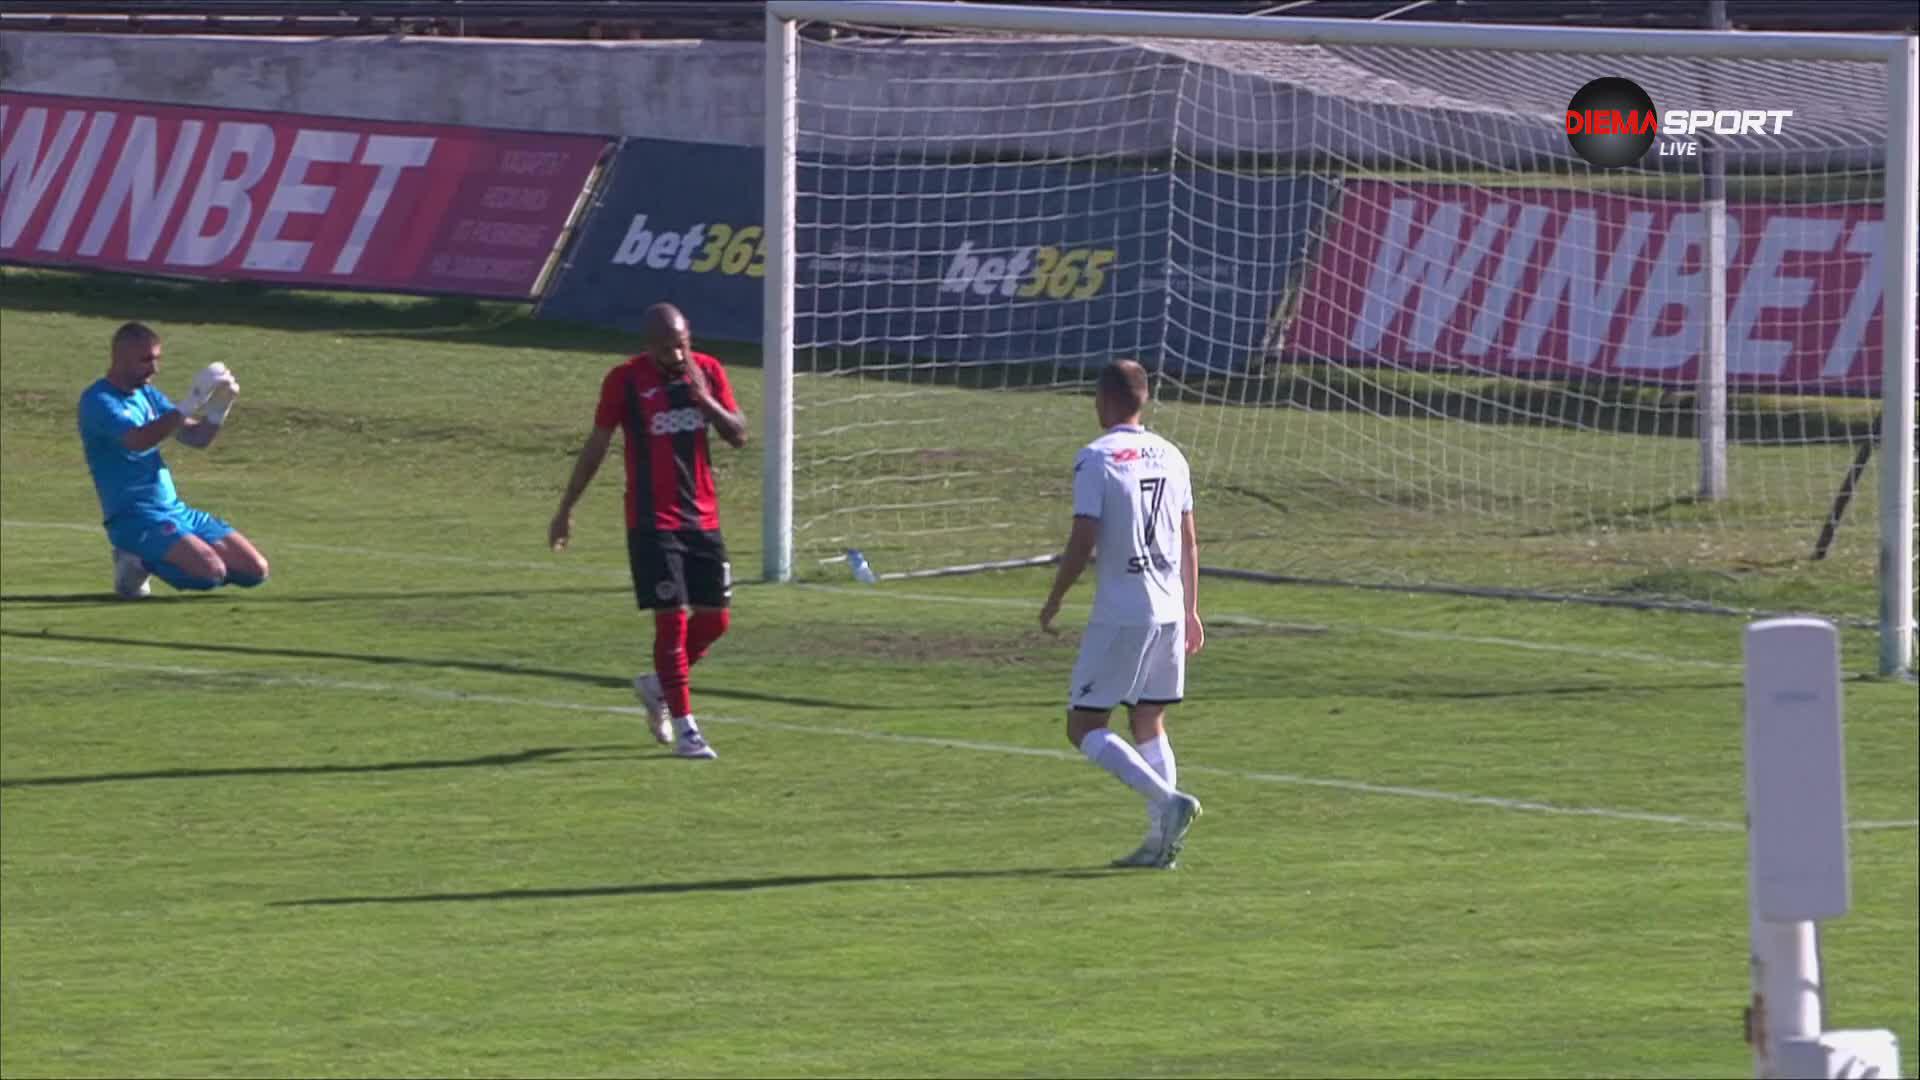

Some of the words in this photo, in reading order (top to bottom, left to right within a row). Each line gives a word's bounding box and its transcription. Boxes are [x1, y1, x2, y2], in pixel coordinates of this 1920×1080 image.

[0, 104, 437, 275] WINBET
[941, 240, 1117, 299] bet365
[1350, 198, 1885, 377] WINBET
[1139, 477, 1167, 548] 7
